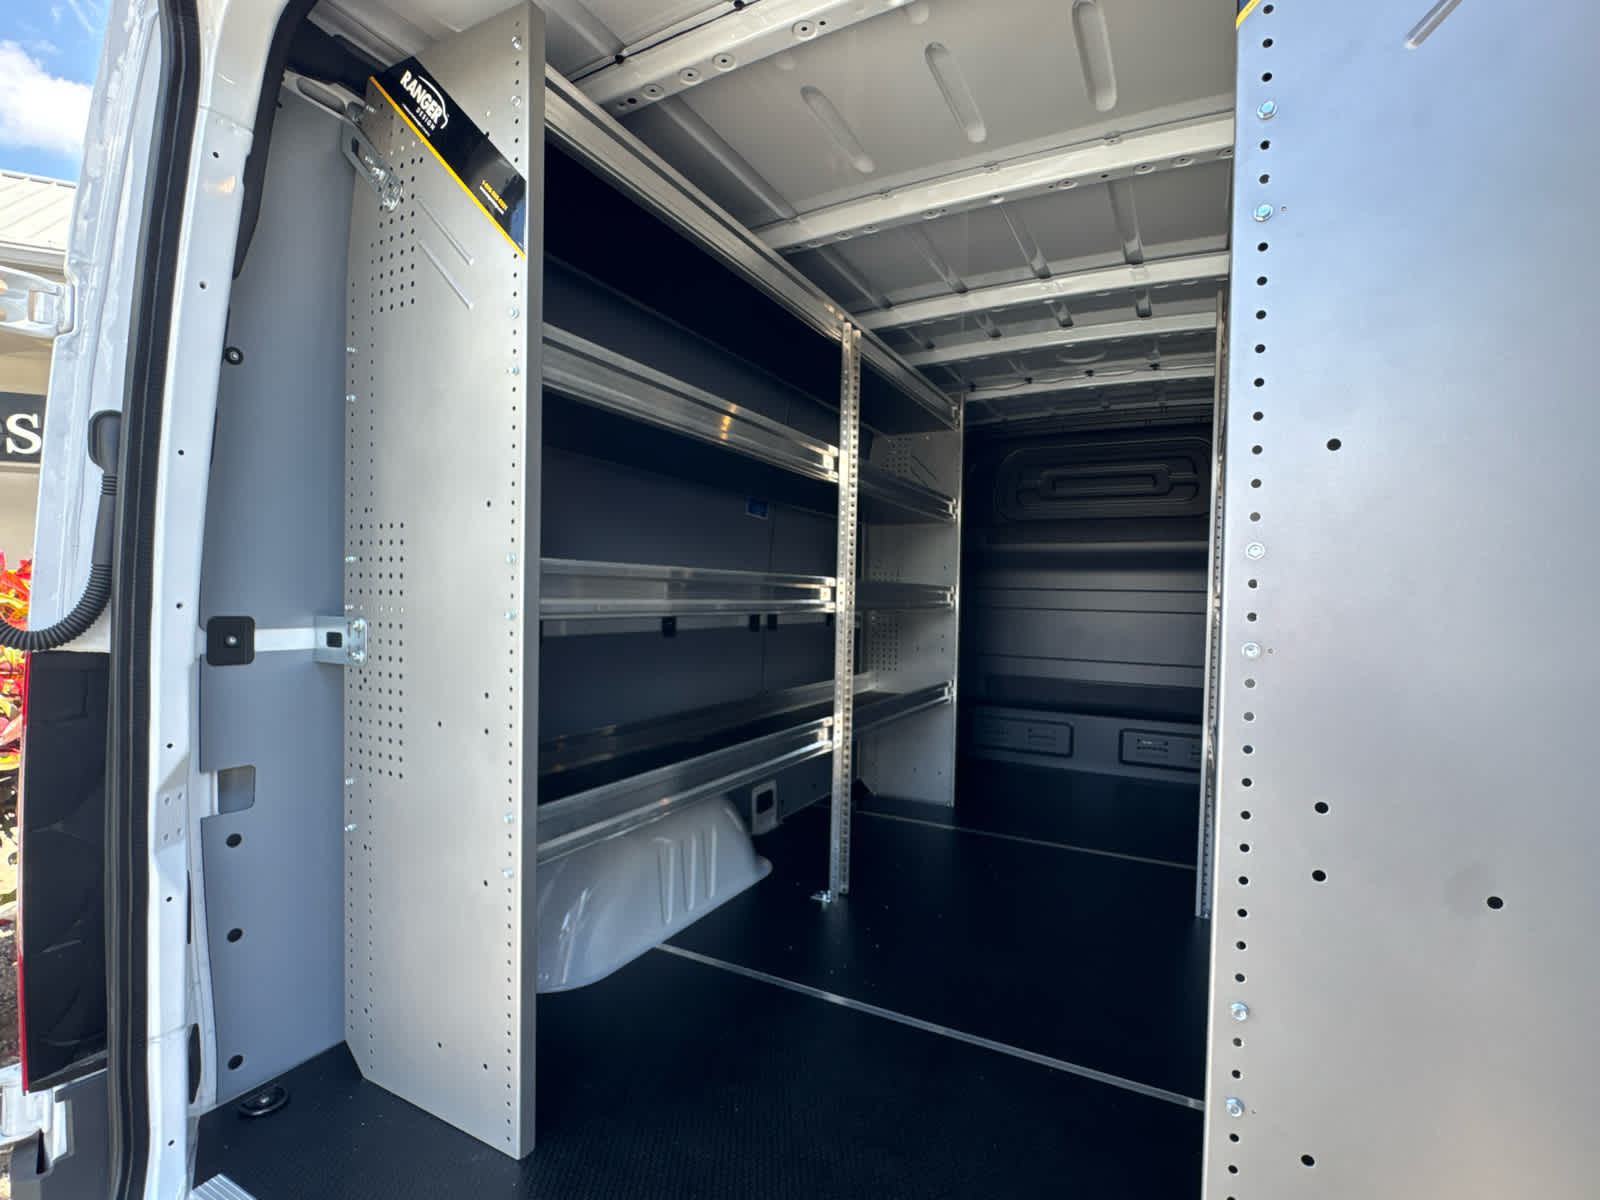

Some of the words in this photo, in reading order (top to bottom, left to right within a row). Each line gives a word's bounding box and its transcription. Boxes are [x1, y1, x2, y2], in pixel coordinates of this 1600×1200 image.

[400, 70, 443, 124] RANGER
[415, 107, 436, 131] DESIGN
[0, 412, 42, 455] S
